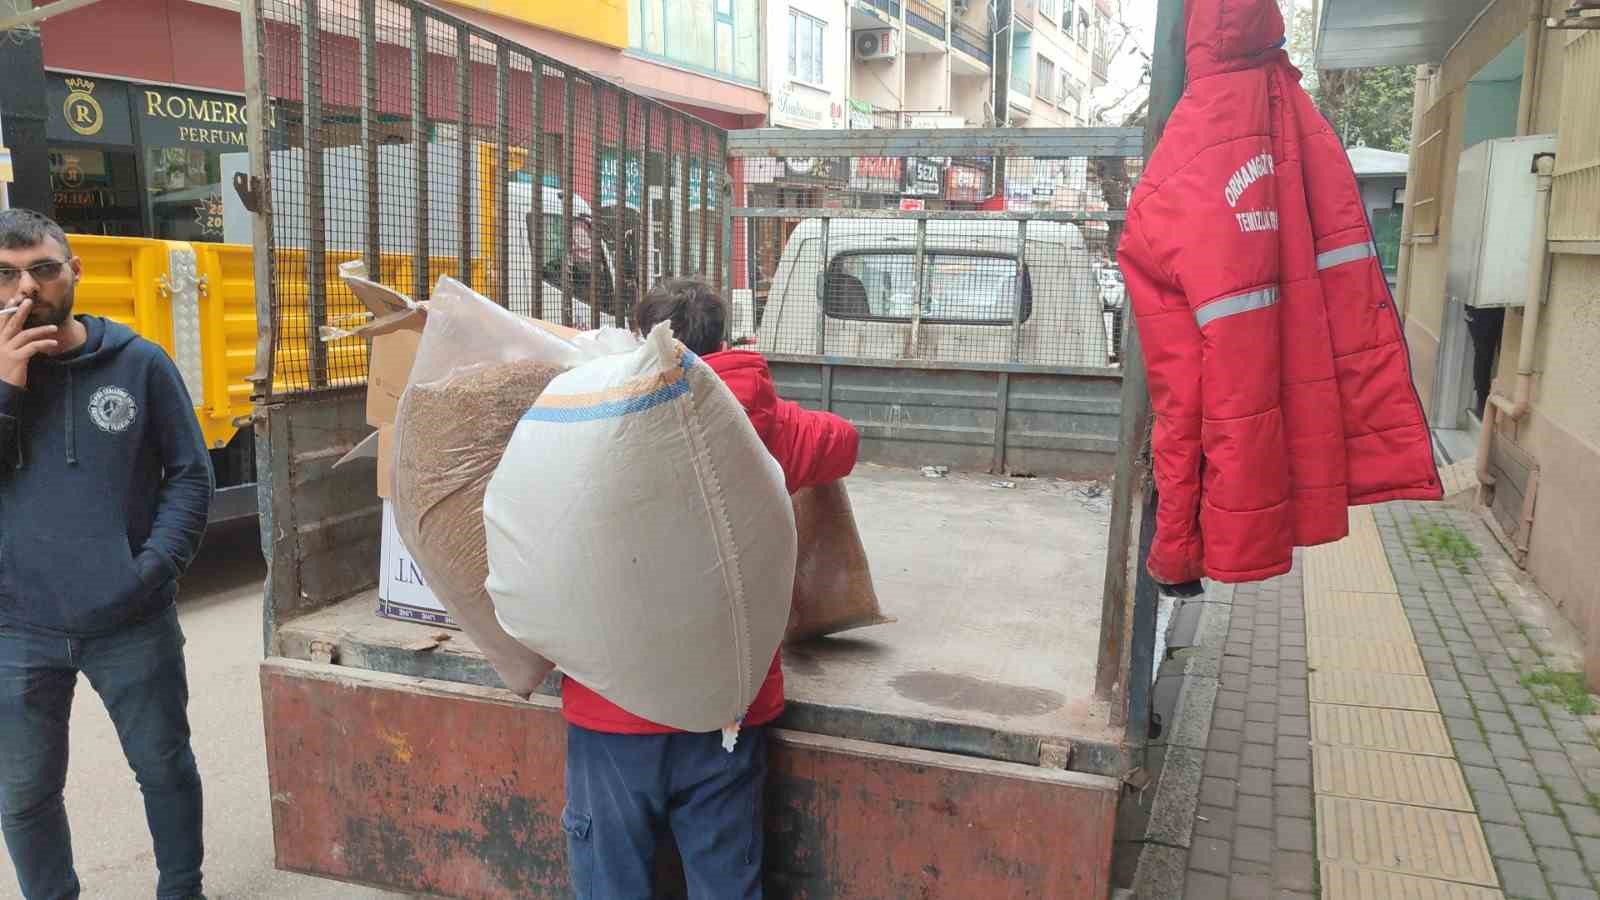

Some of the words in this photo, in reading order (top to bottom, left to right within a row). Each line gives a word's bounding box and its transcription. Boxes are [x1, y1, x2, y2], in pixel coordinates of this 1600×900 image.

[76, 105, 92, 124] R
[144, 90, 276, 128] ROMER
[179, 127, 247, 145] PERFUM
